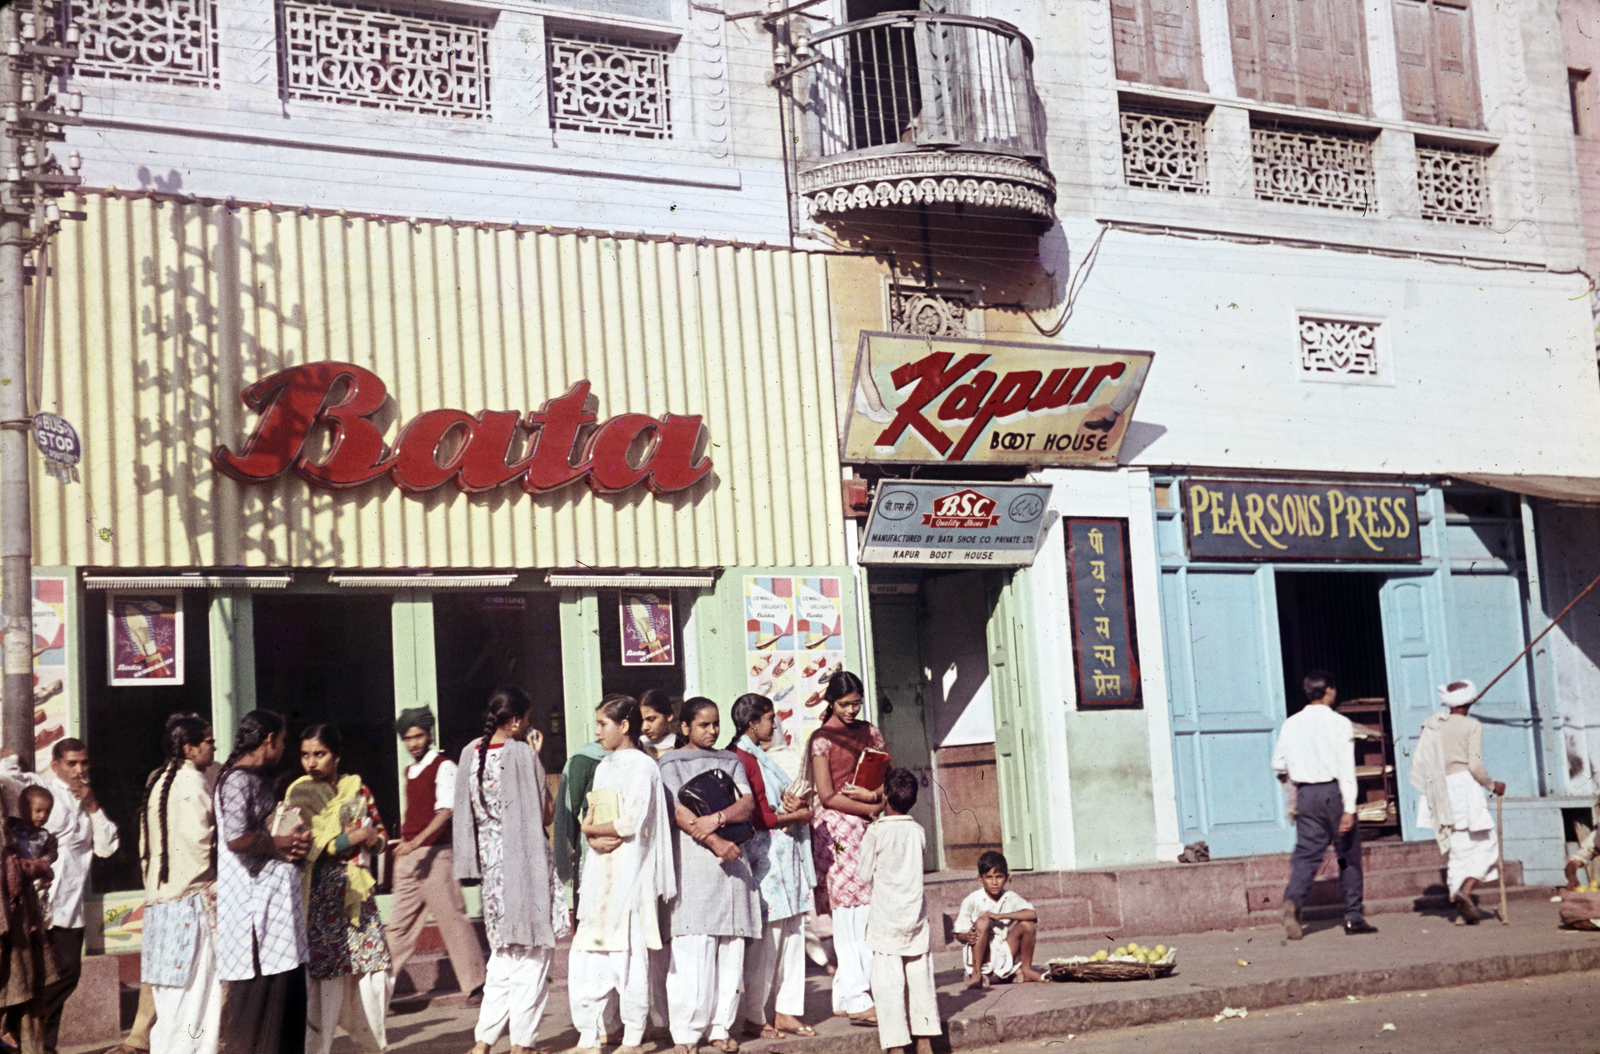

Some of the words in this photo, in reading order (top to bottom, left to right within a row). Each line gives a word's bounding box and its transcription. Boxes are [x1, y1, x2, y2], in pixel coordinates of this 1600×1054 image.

[874, 350, 1126, 461] Kapur
[42, 415, 64, 434] BUS
[210, 359, 715, 496] Bata
[38, 430, 74, 452] STOP
[989, 431, 1036, 450] BOOT
[1043, 434, 1108, 452] HOUSE
[936, 493, 990, 517] B.S.C.
[935, 518, 960, 528] Quality
[964, 519, 984, 527] Shoes
[1189, 484, 1324, 550] PEARSONS
[1326, 489, 1410, 552] PRESS
[871, 534, 921, 543] MANUFACTURED
[925, 535, 935, 543] BY
[938, 535, 953, 543] BATA
[957, 536, 977, 544] SHOE
[995, 536, 1020, 544] PRIVATE
[892, 551, 920, 559] KAPUR
[930, 551, 953, 559] BOOT
[964, 551, 994, 560] HOUSE
